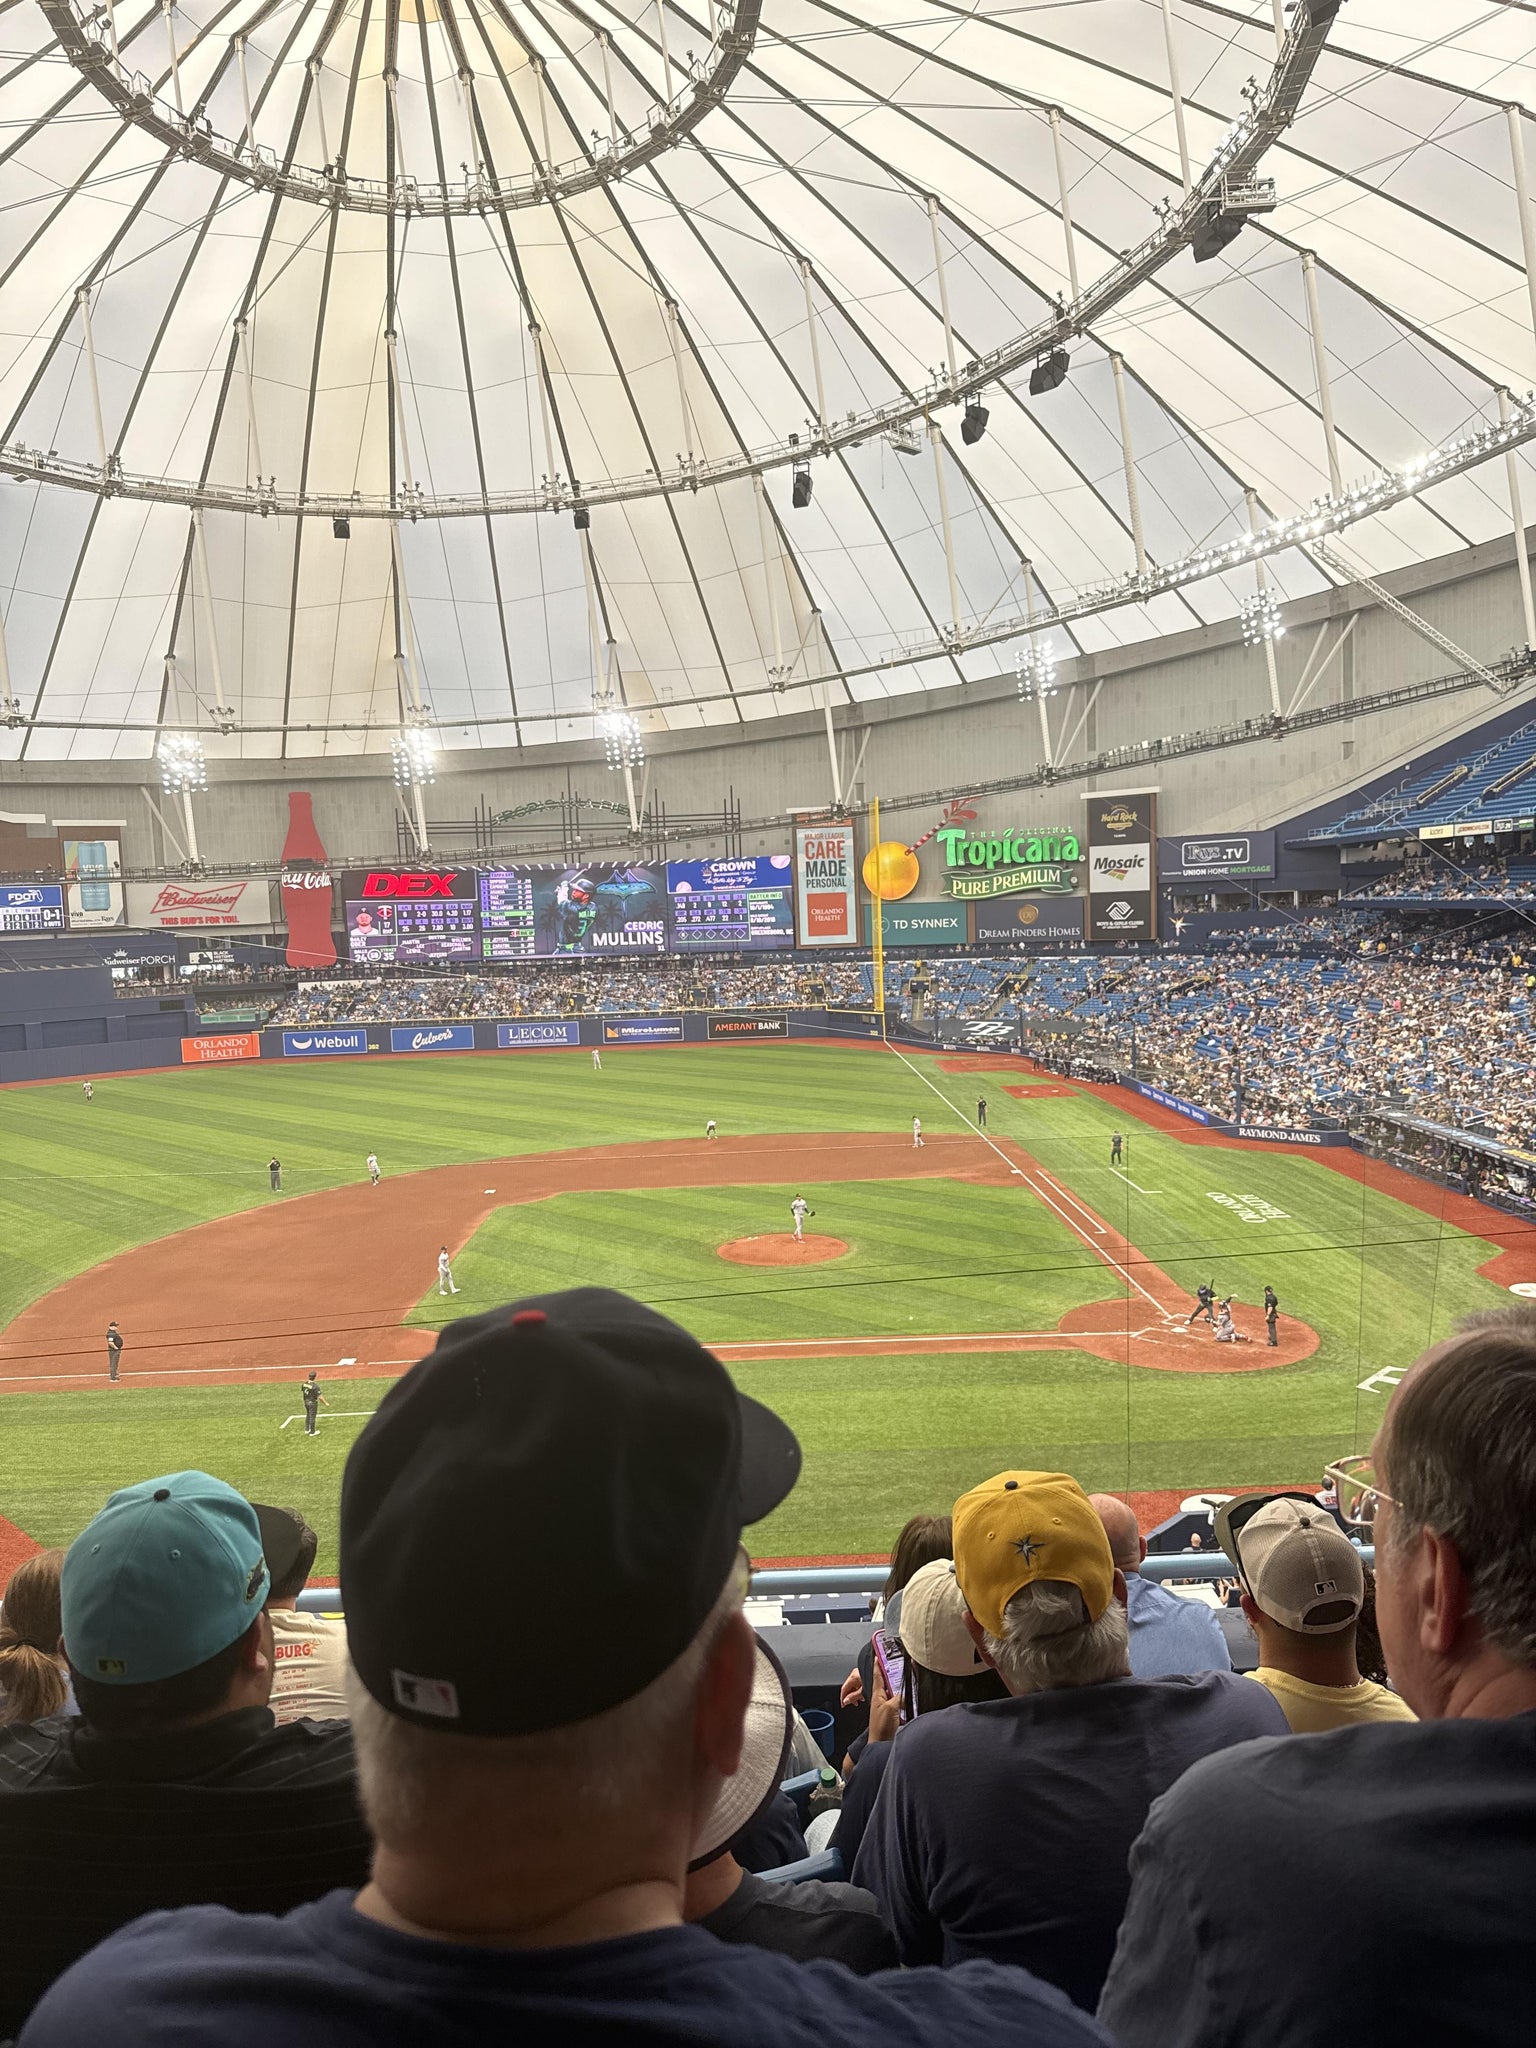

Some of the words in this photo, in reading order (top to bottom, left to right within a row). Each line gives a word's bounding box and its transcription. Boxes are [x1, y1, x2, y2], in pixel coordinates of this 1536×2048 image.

[1101, 813, 1119, 822] Hard
[1120, 811, 1138, 822] Rock
[1019, 826, 1073, 835] ORIGINAL
[805, 840, 845, 860] CARE
[937, 827, 1081, 870] Tropicana
[711, 860, 756, 872] CROWN
[1093, 854, 1145, 870] Mosaic
[805, 860, 846, 878] MADE
[1230, 865, 1271, 873] MORTGAGE
[362, 873, 458, 897] DEX
[806, 877, 847, 888] PERSONAL
[952, 879, 990, 895] PURE
[992, 869, 1061, 892] PREMIUM
[8, 893, 36, 901] FDOT
[159, 892, 238, 906] Budweiser
[43, 909, 60, 921] 0-1
[811, 907, 844, 915] ORLANDO
[160, 917, 179, 925] THIS
[180, 917, 204, 925] BUD'S
[205, 916, 220, 924] FOR
[221, 915, 240, 923] YOU.
[625, 921, 664, 931] CEDRIC
[893, 919, 908, 929] TD
[911, 918, 958, 929] SYNNEX
[593, 931, 664, 946] MULLINS
[979, 928, 1010, 938] DREAM
[1011, 928, 1046, 938] FINDERS
[1049, 927, 1080, 936] HOMES
[141, 955, 176, 965] PORCH
[508, 1026, 568, 1039] LECOM
[715, 1023, 757, 1031] AMERANT
[758, 1022, 781, 1030] BANK
[193, 1038, 248, 1049] ORLANDO
[314, 1036, 358, 1048] Webull
[412, 1028, 453, 1049] Culver's
[201, 1048, 243, 1059] HEALTH
[1239, 1127, 1287, 1140] RAYMOND
[1288, 1132, 1321, 1143] JAMES
[275, 1643, 311, 1659] BURG
